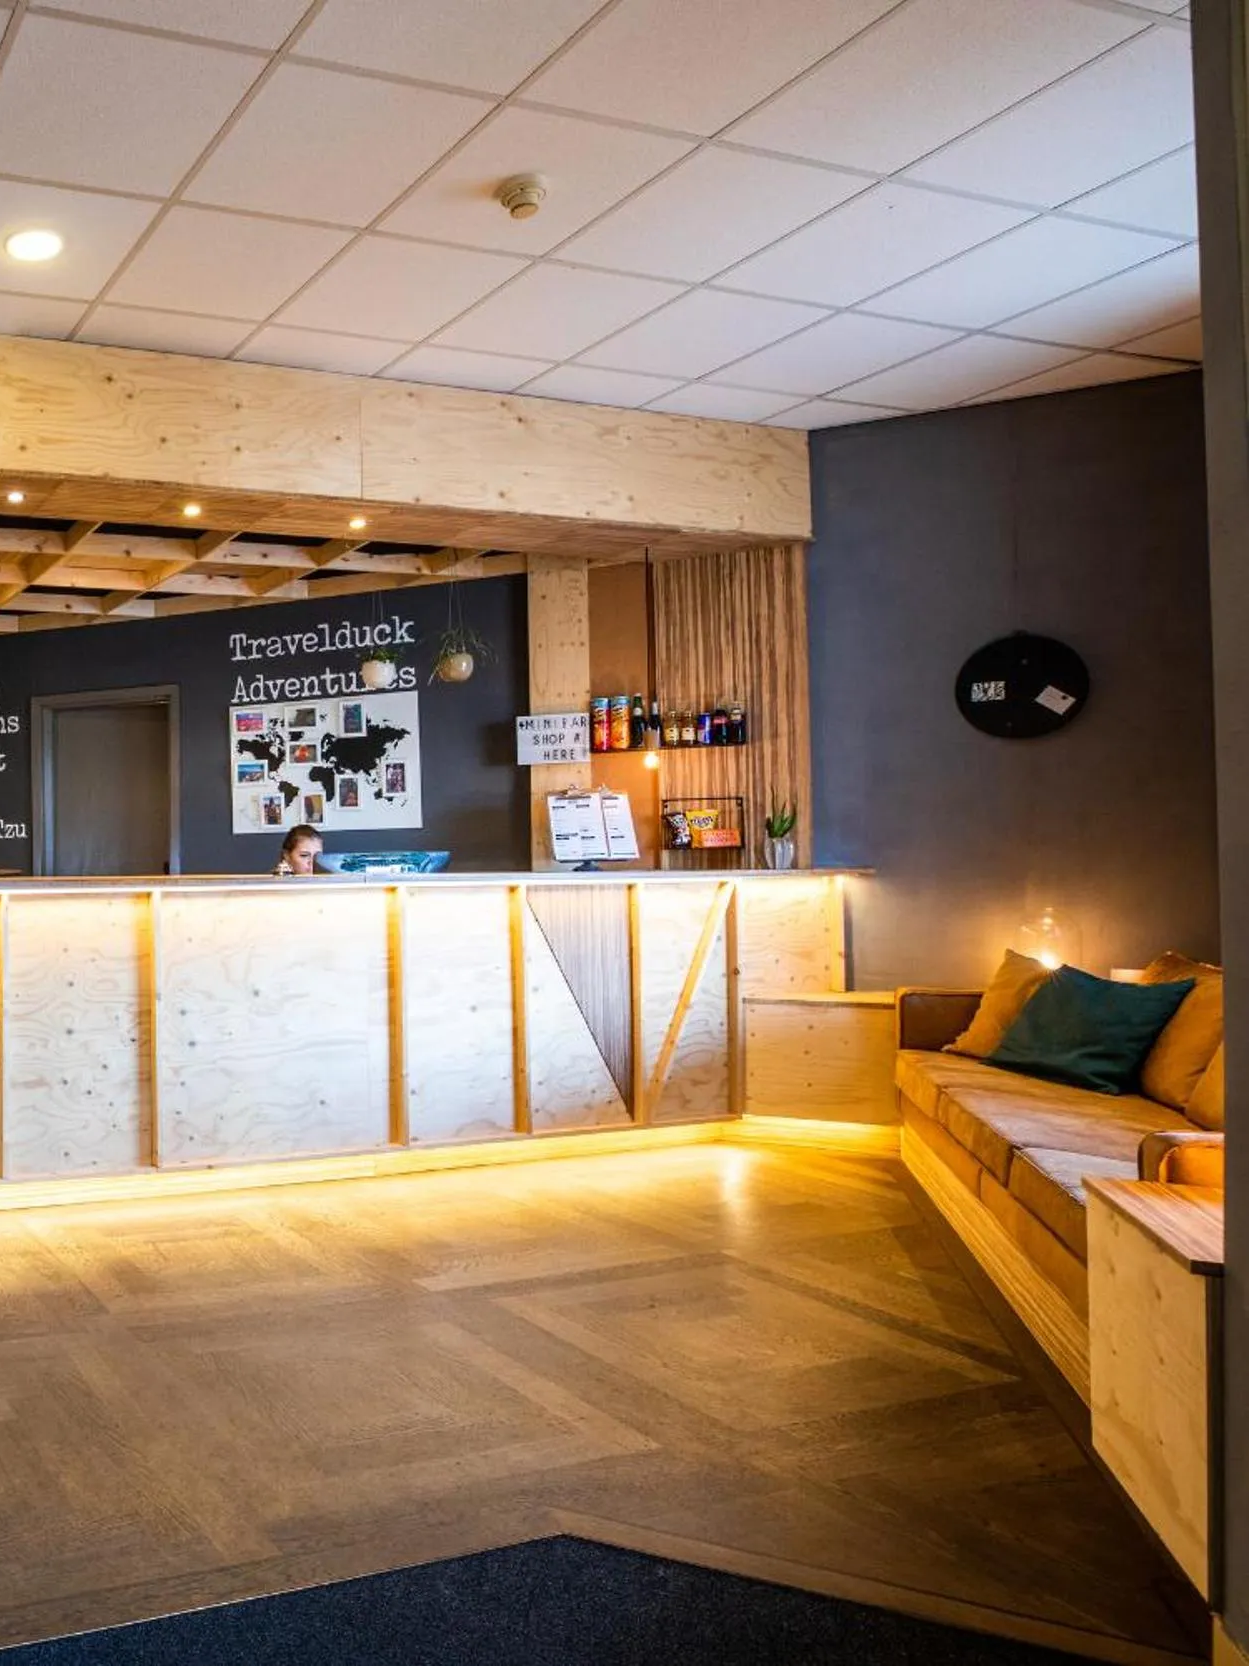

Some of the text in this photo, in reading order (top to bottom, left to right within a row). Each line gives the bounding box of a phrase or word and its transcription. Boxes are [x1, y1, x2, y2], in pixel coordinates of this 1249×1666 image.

[229, 615, 415, 661] Travelduck
[231, 666, 417, 703] Adventus
[533, 734, 565, 746] SHOP
[543, 748, 575, 761] HERE
